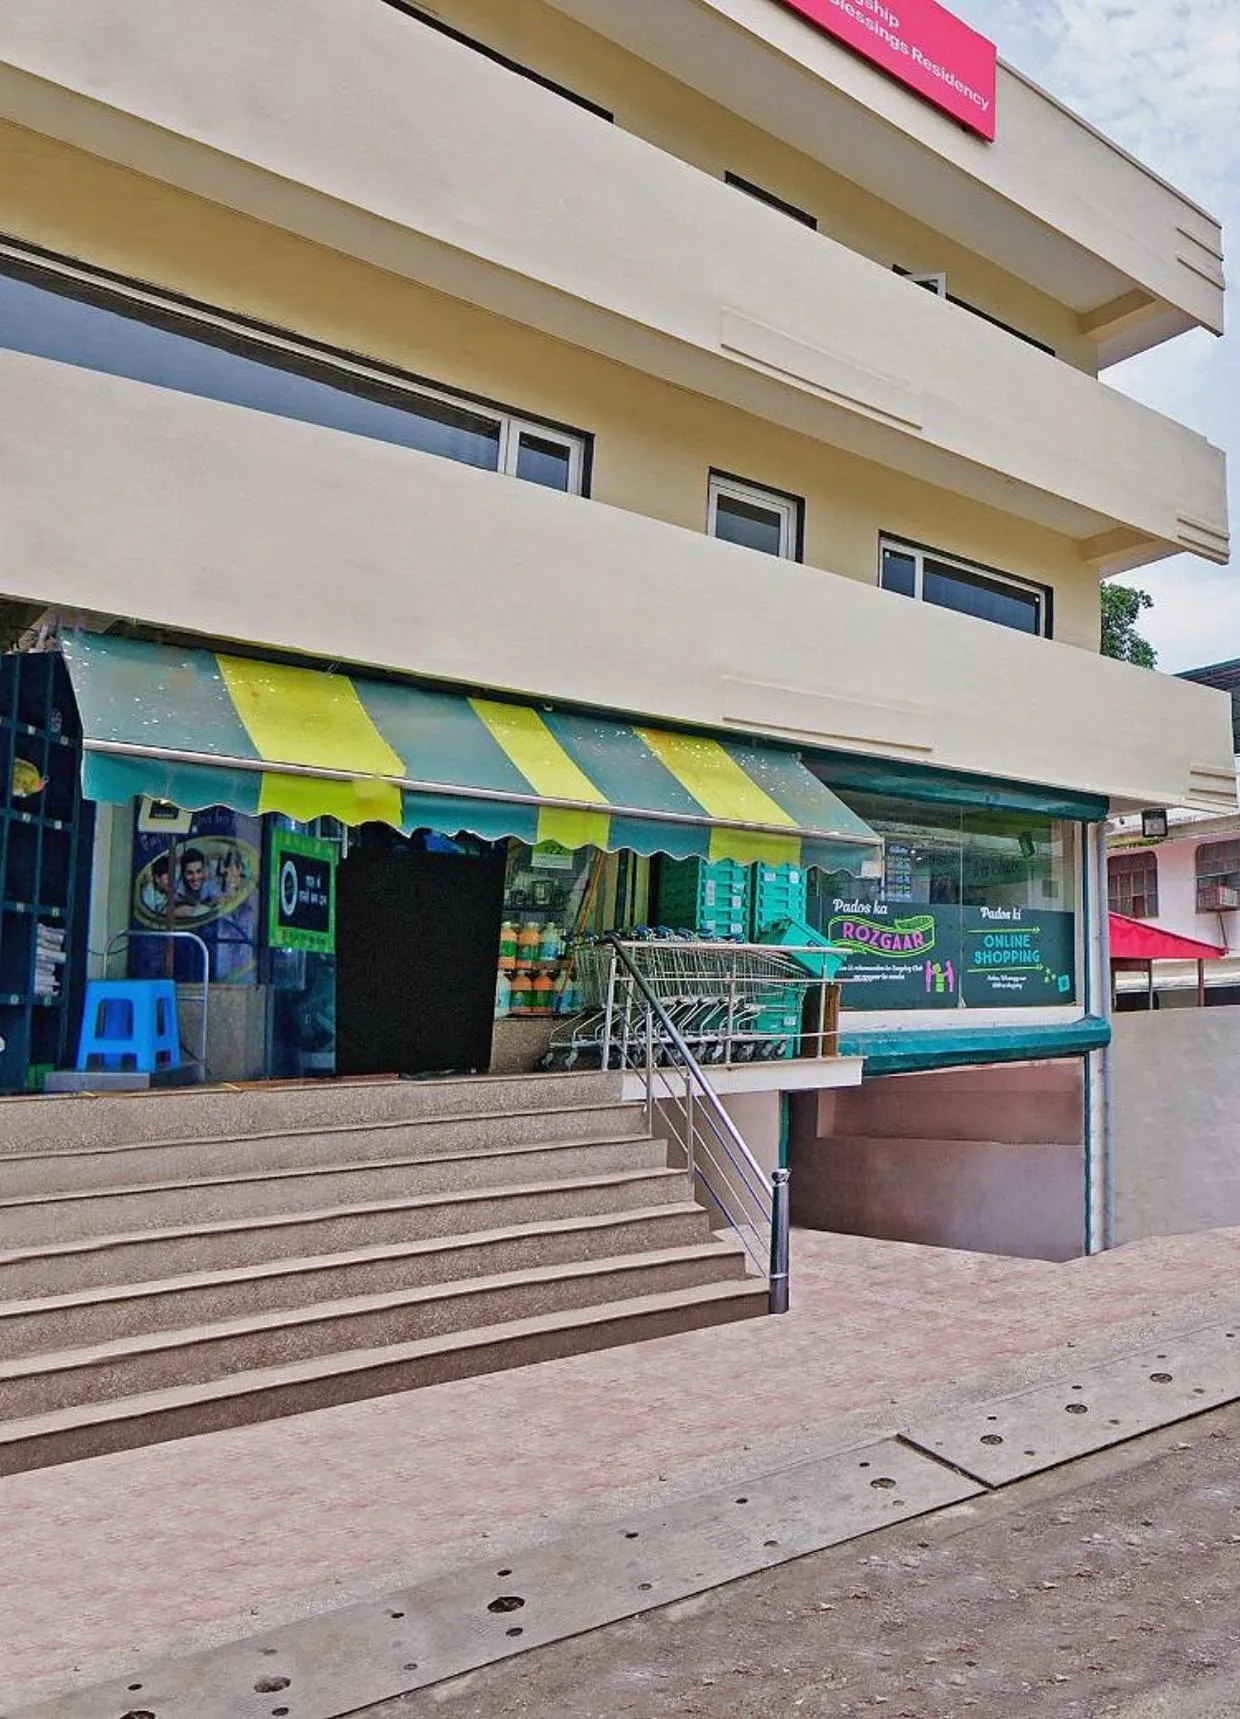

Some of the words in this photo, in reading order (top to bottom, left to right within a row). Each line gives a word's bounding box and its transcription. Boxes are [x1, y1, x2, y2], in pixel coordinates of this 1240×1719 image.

[912, 46, 989, 111] Residency
[833, 899, 872, 914] Pados
[873, 901, 888, 915] ka
[980, 907, 1010, 920] Pados
[842, 921, 924, 951] ROZGAAR
[983, 934, 1031, 948] ONLINE
[974, 950, 1040, 965] SHOPPING
